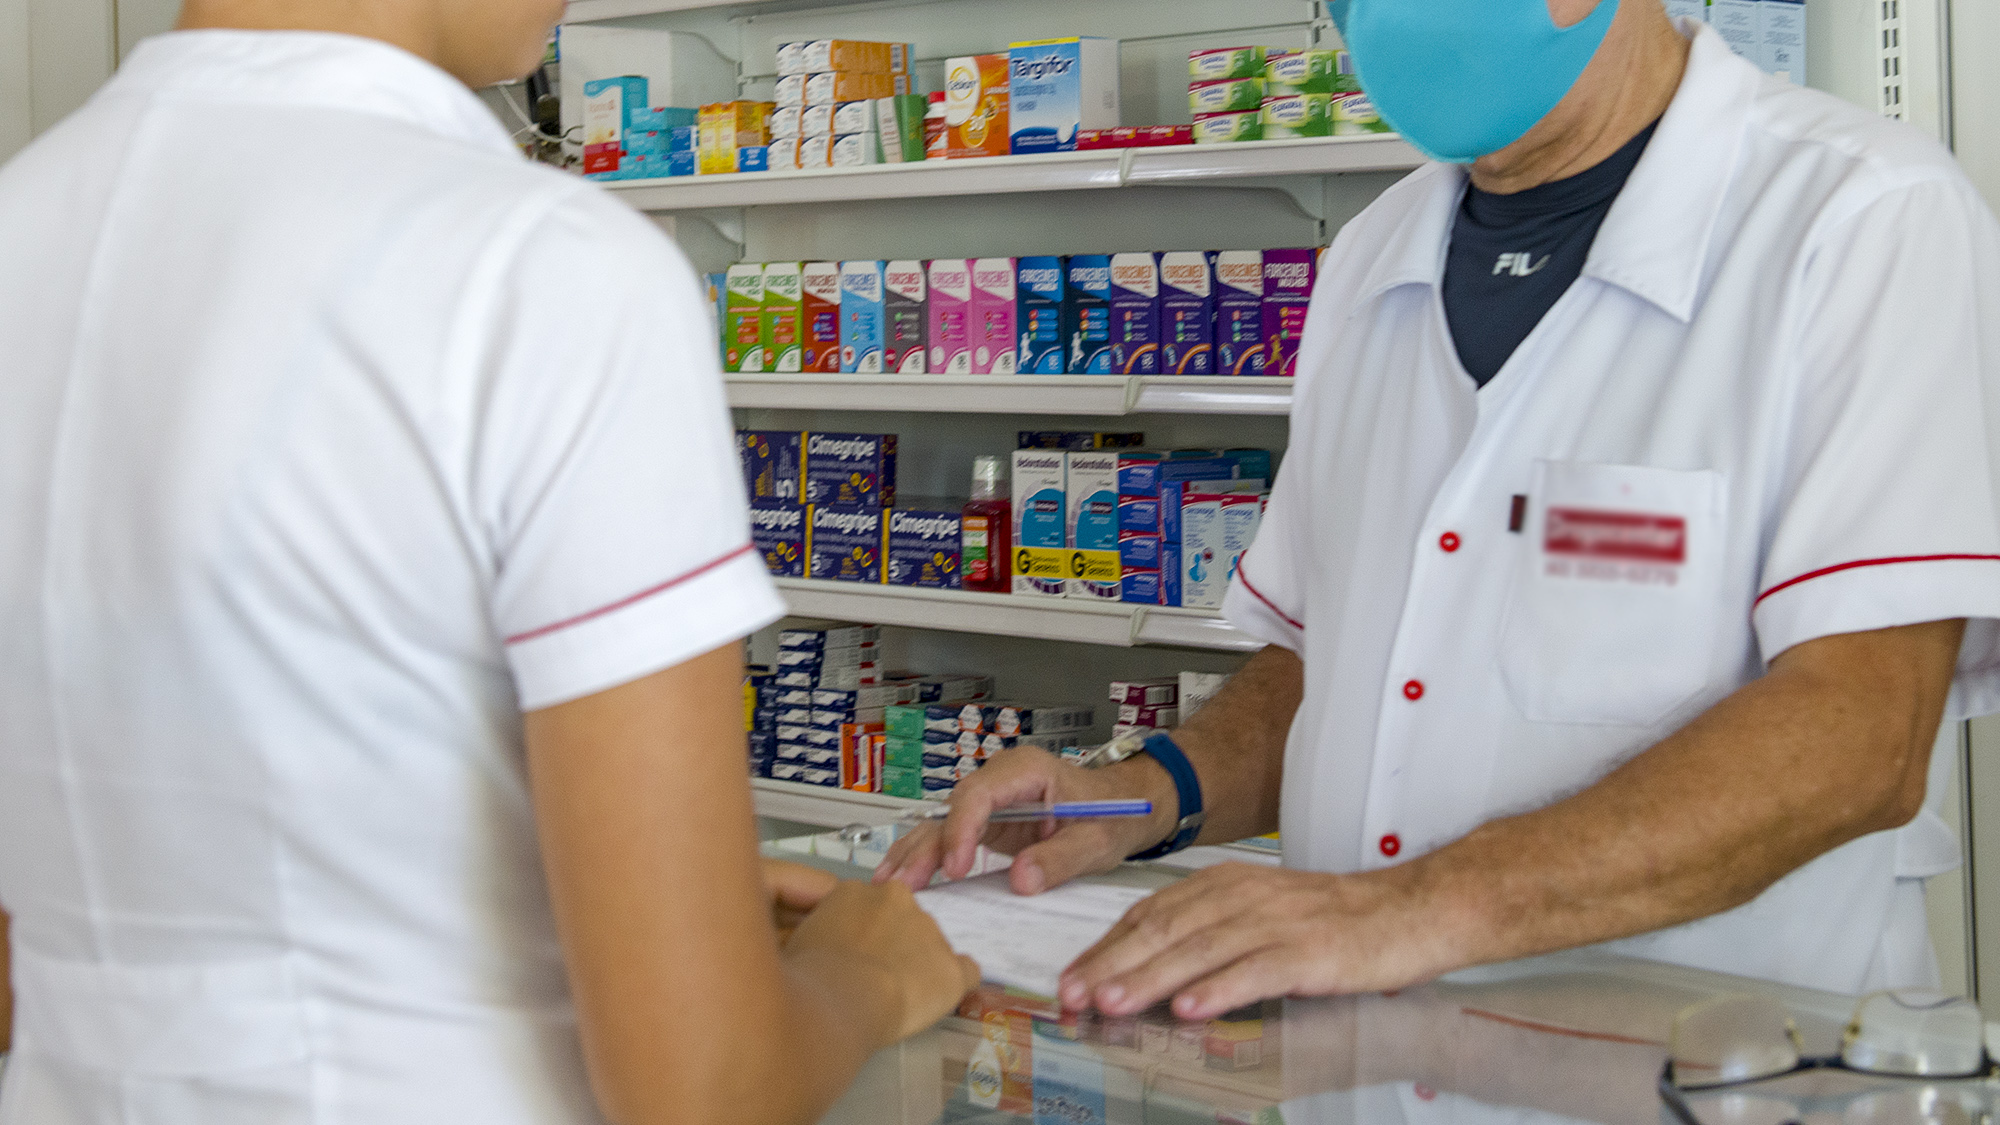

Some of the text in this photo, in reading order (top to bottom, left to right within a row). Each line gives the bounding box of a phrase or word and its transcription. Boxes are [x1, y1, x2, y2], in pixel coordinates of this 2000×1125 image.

[1011, 54, 1076, 80] Targifor
[808, 434, 877, 461] Cimegripe
[750, 506, 801, 531] megripe
[813, 507, 879, 534] Cimegripe
[890, 511, 960, 539] Cimegripe
